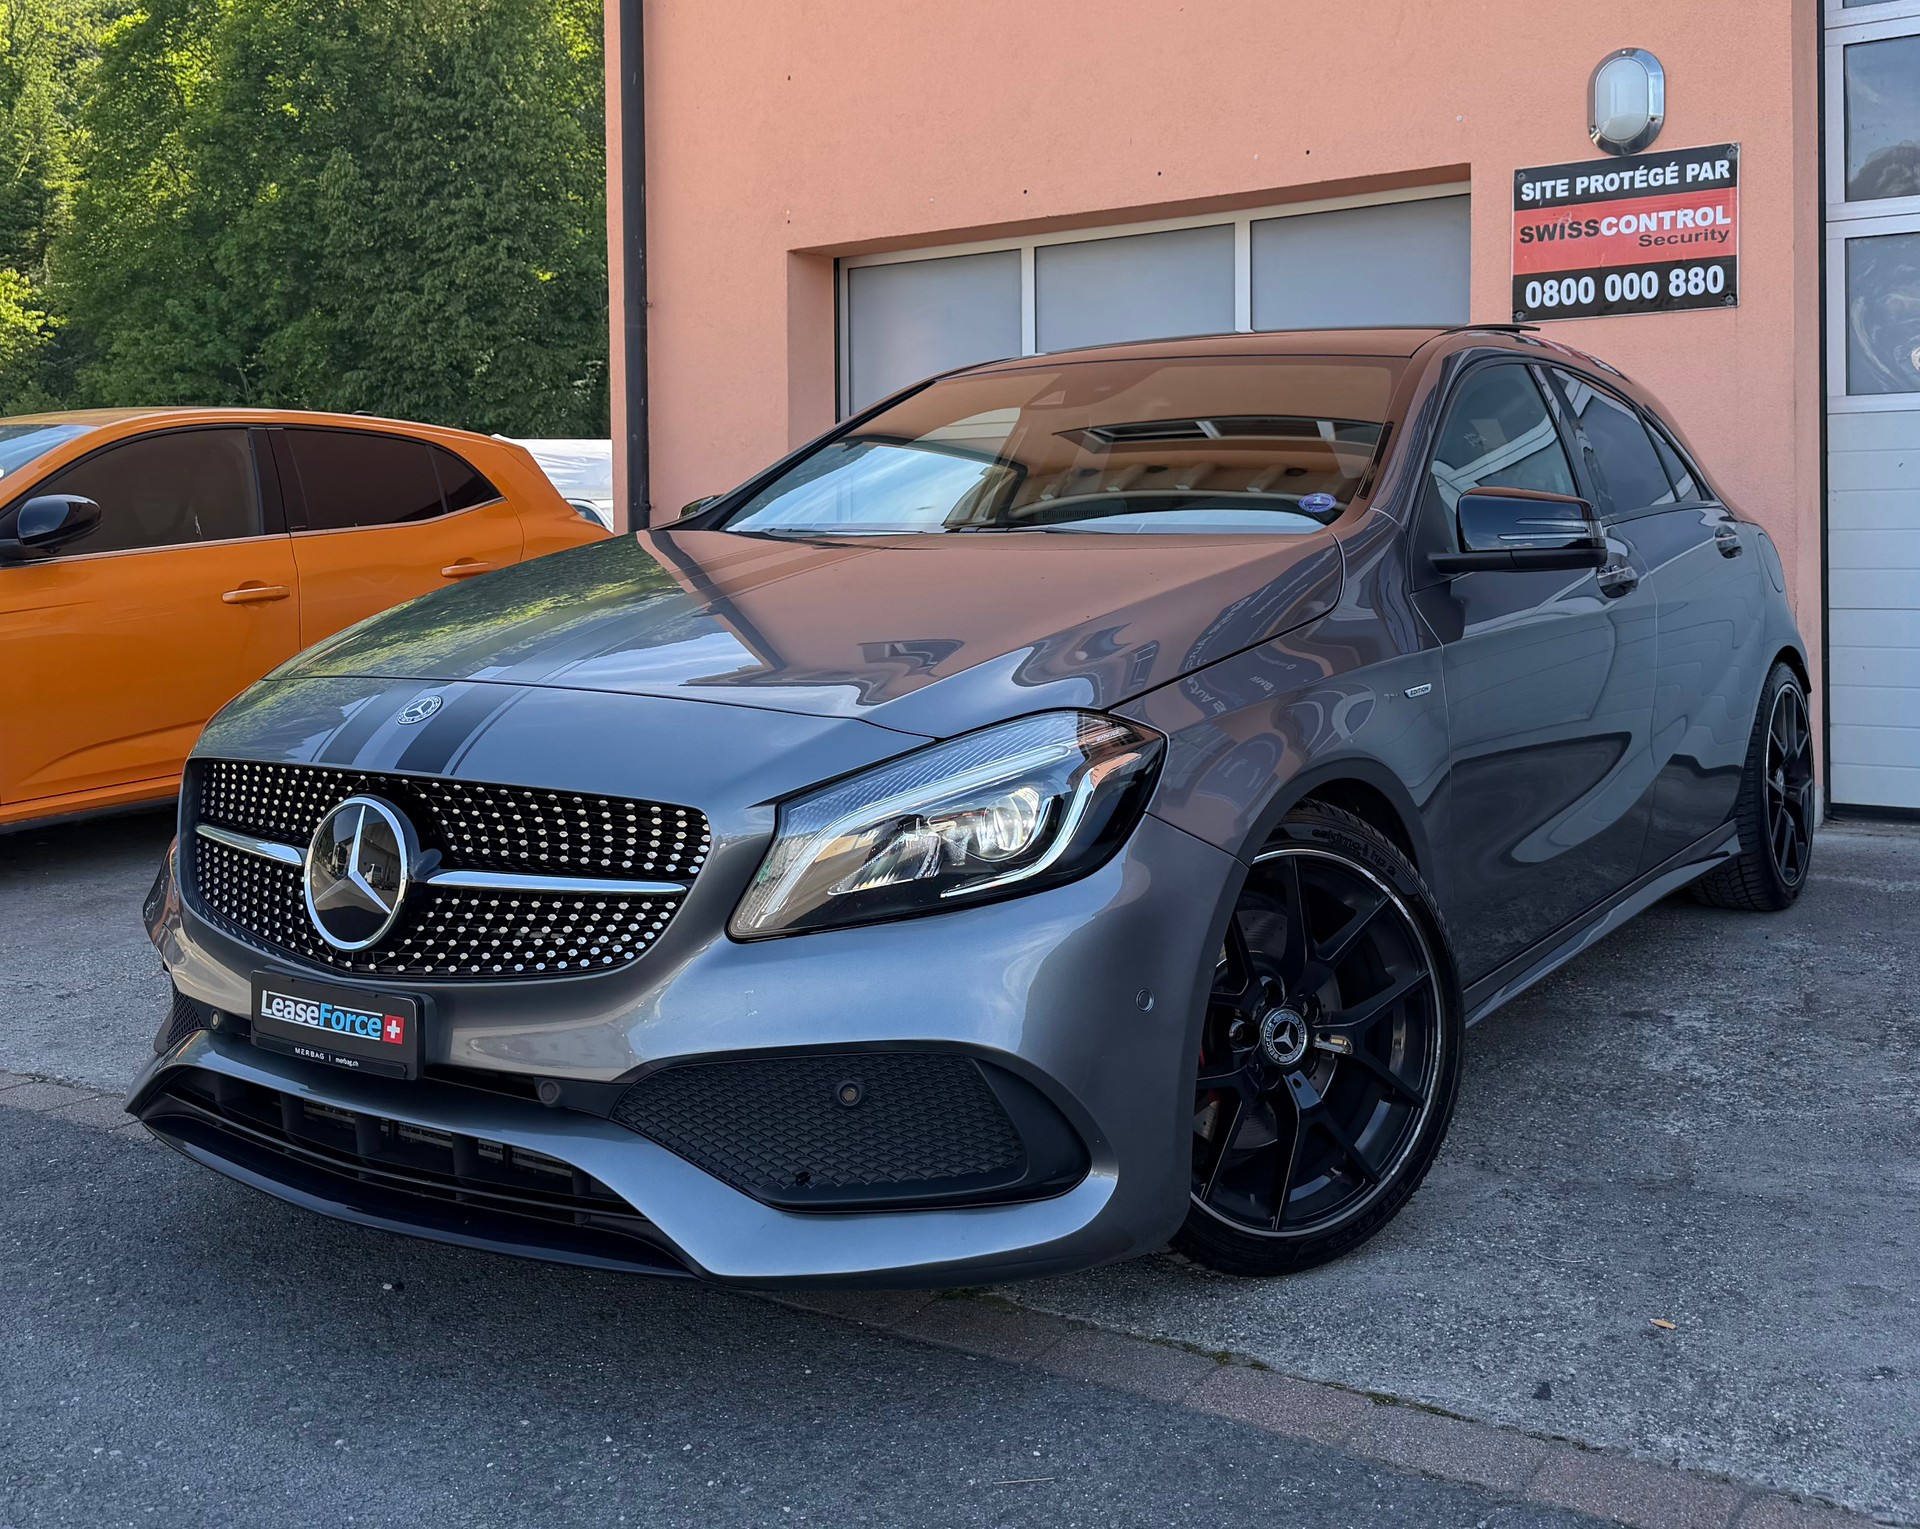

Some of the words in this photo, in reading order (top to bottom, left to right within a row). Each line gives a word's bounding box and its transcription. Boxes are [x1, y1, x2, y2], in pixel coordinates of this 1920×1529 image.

[1521, 178, 1569, 202] SITE
[1575, 161, 1679, 196] PROTÉGÉ
[1686, 159, 1730, 183] PAR
[1519, 205, 1732, 244] SWISSCONTROL
[1638, 227, 1730, 248] Security
[1525, 276, 1596, 309] 0800
[1604, 270, 1659, 302] 000
[1668, 265, 1725, 297] 880
[260, 989, 382, 1038] LeaseForce
[294, 1046, 325, 1060] MERBAG
